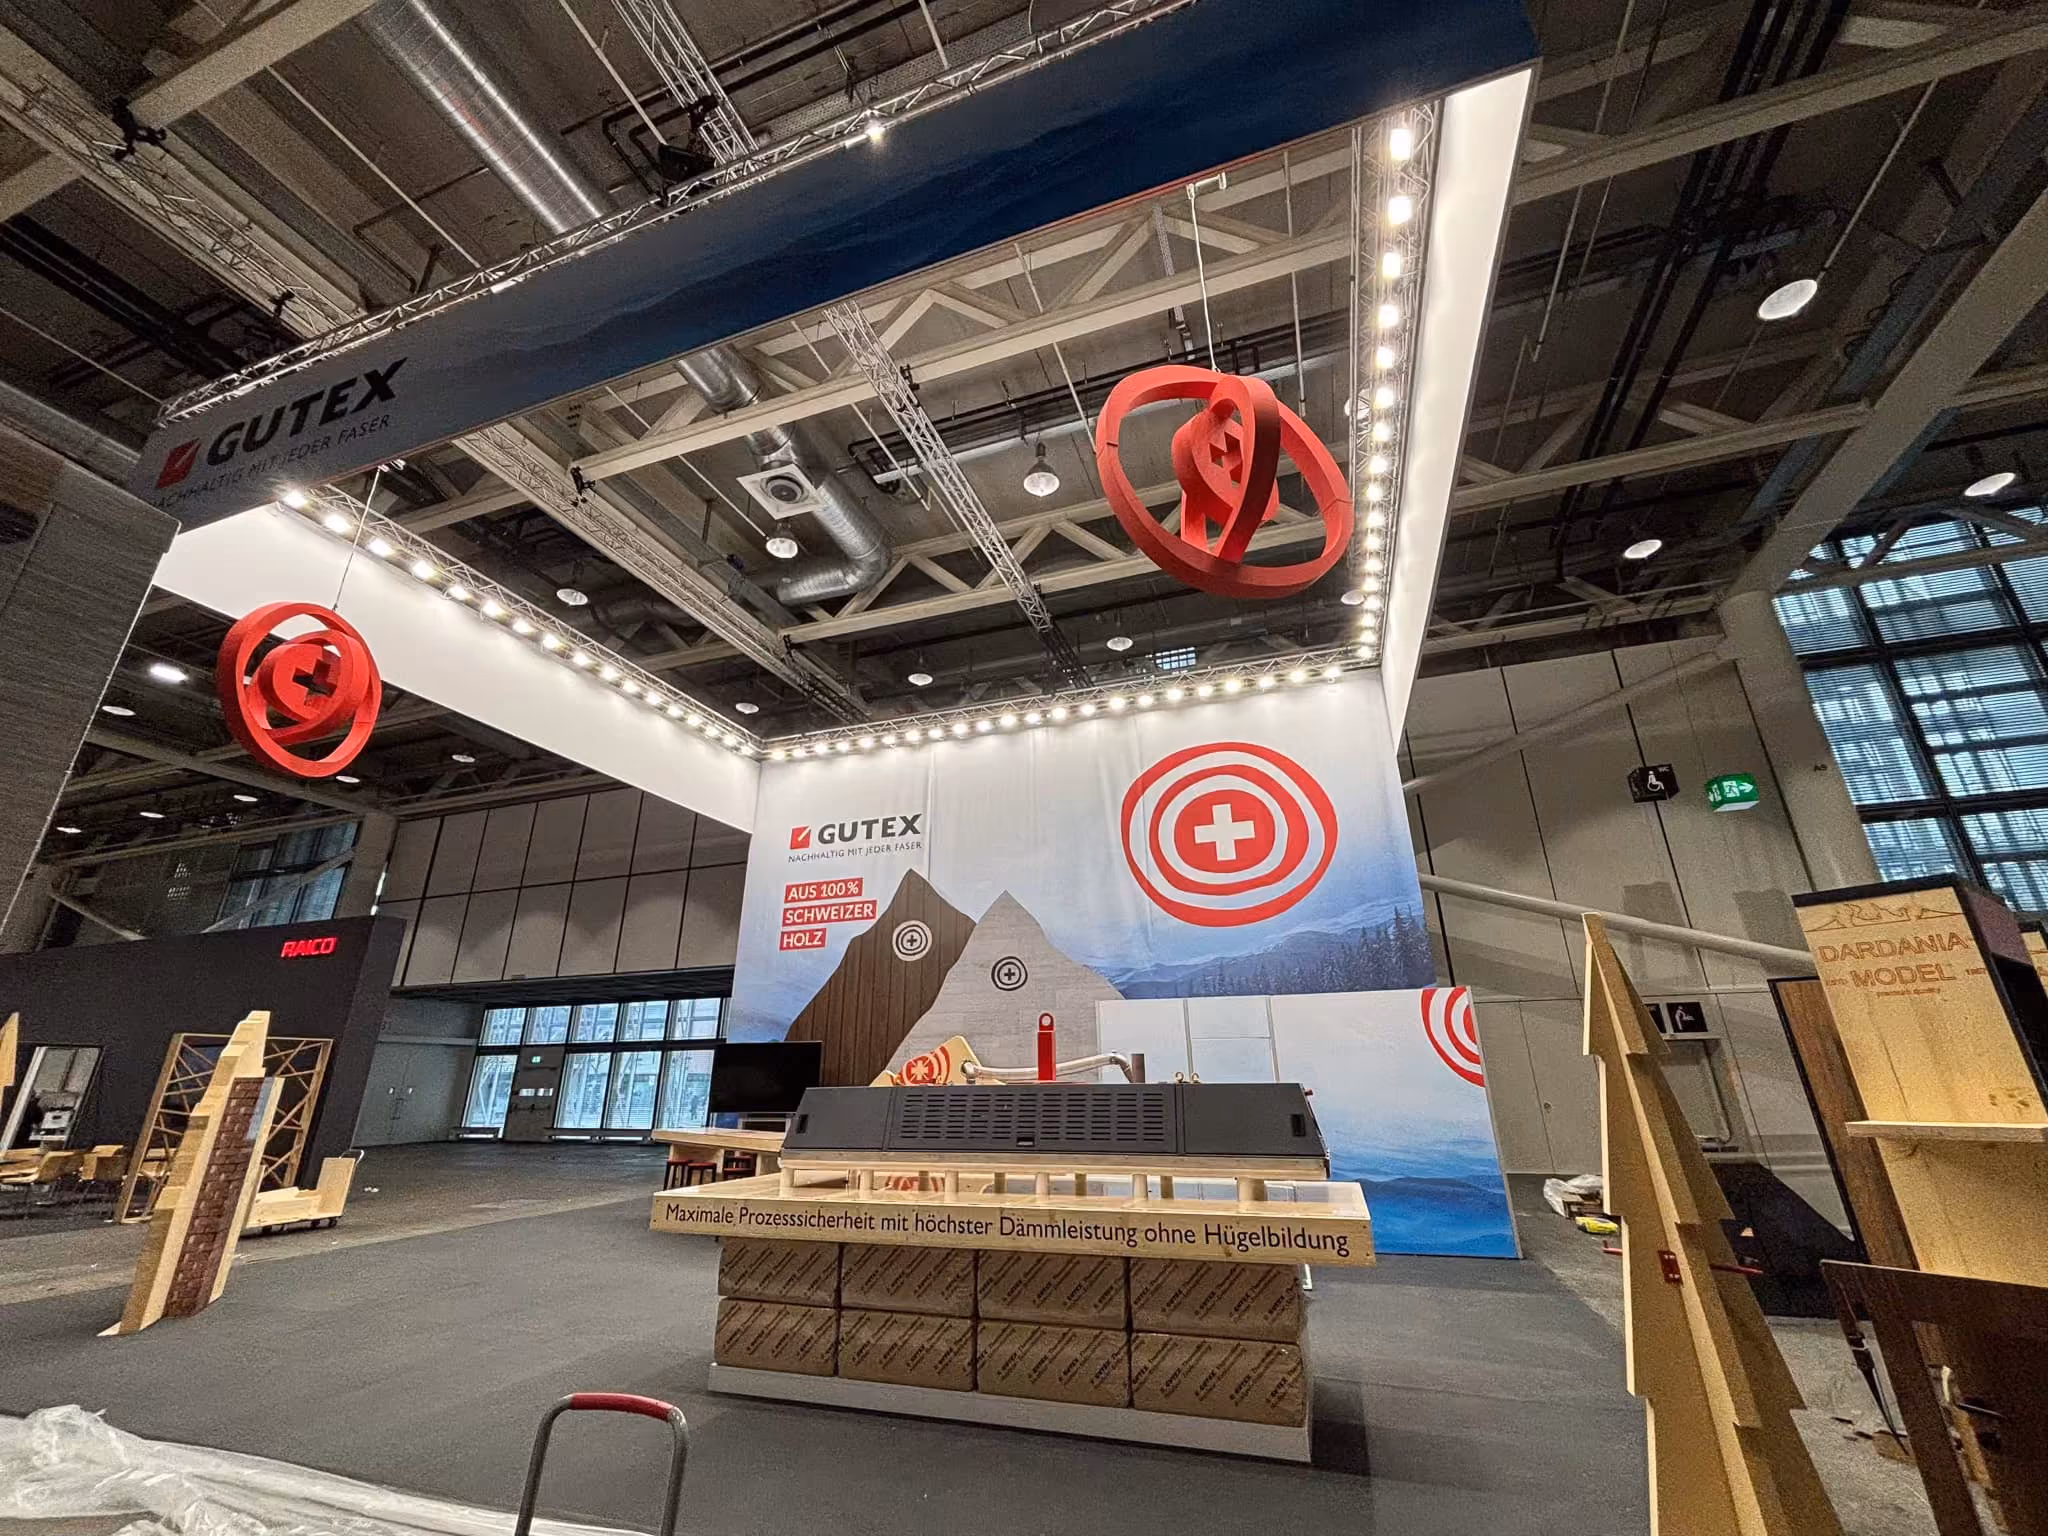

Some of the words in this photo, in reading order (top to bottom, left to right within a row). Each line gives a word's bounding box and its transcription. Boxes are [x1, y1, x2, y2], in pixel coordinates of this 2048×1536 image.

[207, 357, 408, 466] GUTEX
[337, 414, 390, 446] FASER
[817, 813, 922, 845] GUTEX
[788, 850, 845, 863] NACHHALTIG
[847, 847, 863, 856] MIT
[865, 844, 892, 857] JEDER
[895, 841, 922, 852] FASER
[787, 885, 817, 901] AUS
[785, 903, 873, 924] SCHWEIZER
[281, 937, 337, 958] RAICO
[782, 931, 824, 948] HOLZ
[1818, 932, 1970, 963] DARDANIA
[1850, 963, 1957, 988] MODEL
[665, 1203, 734, 1225] Maximale
[738, 1206, 875, 1231] Prozesssicherheit
[881, 1209, 908, 1232] mit
[914, 1210, 993, 1236] höchster
[1000, 1215, 1137, 1247] Dämmleistung
[1144, 1222, 1196, 1244] ohne
[1204, 1223, 1349, 1258] Hügelbildung
